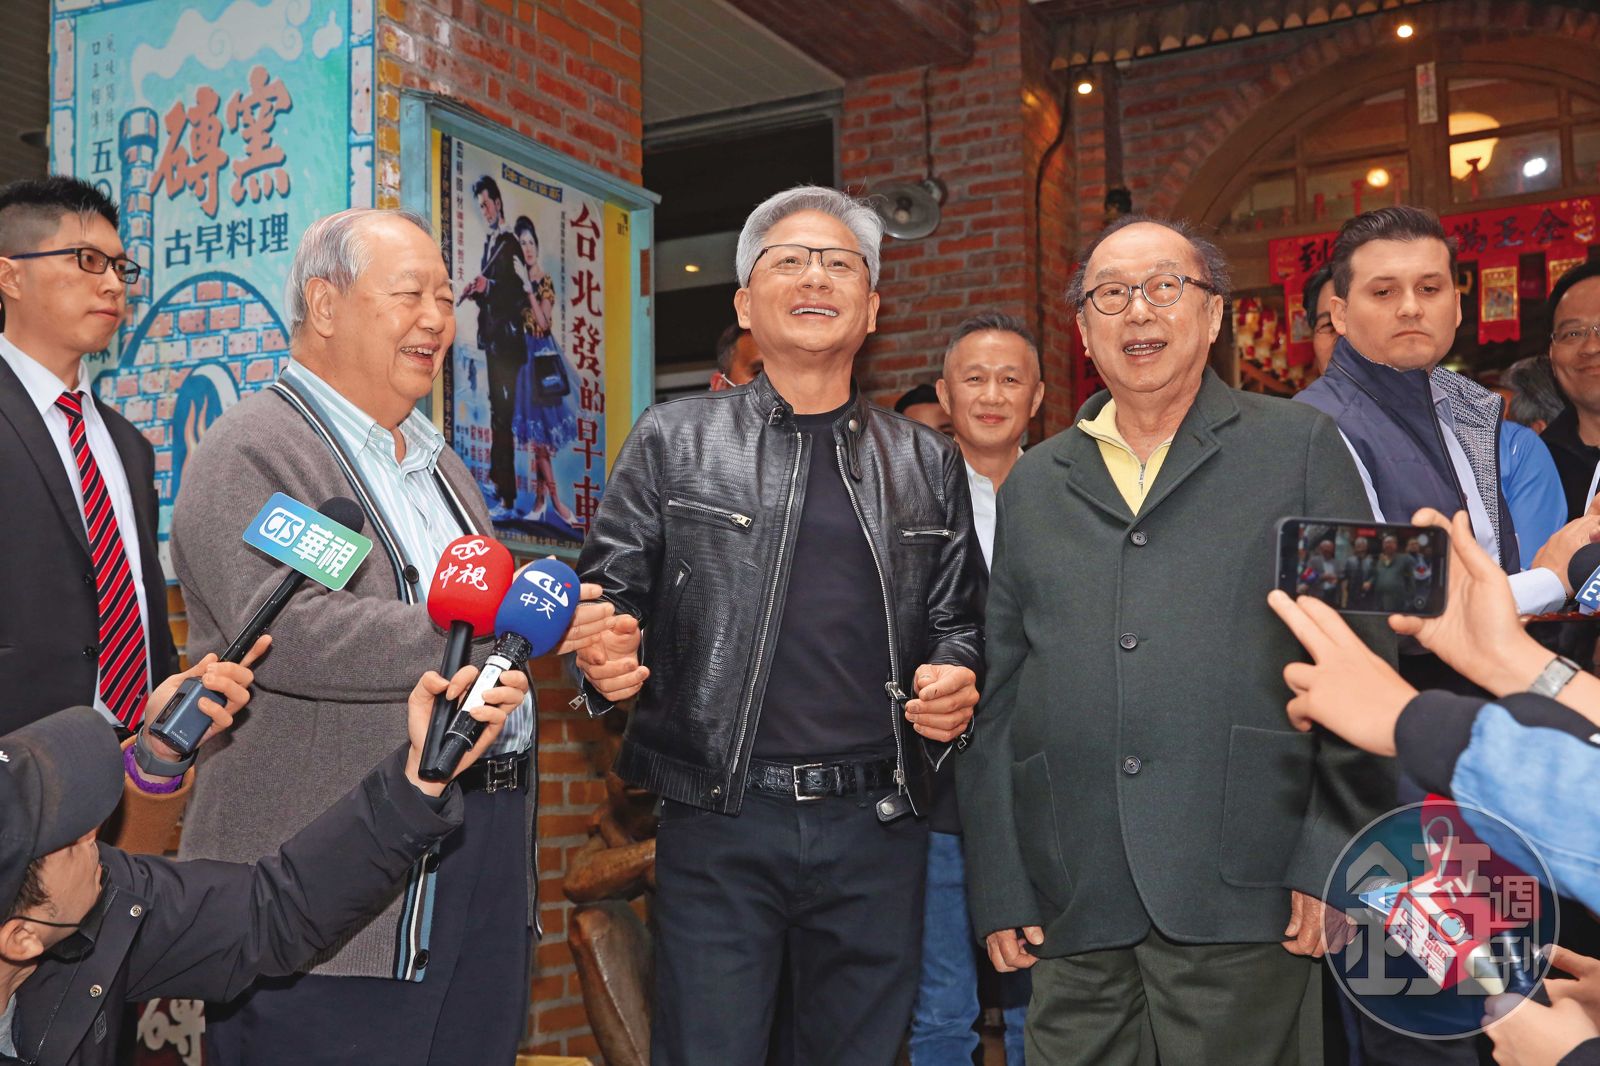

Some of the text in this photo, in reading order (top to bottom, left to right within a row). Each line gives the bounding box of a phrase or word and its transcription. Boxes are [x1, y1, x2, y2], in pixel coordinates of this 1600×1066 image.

[164, 212, 289, 269] 古早料理
[570, 203, 605, 536] 台北發的早車
[263, 510, 303, 543] CTS
[292, 523, 359, 578] 華視
[440, 562, 489, 591] 中視
[520, 592, 557, 620] 中天
